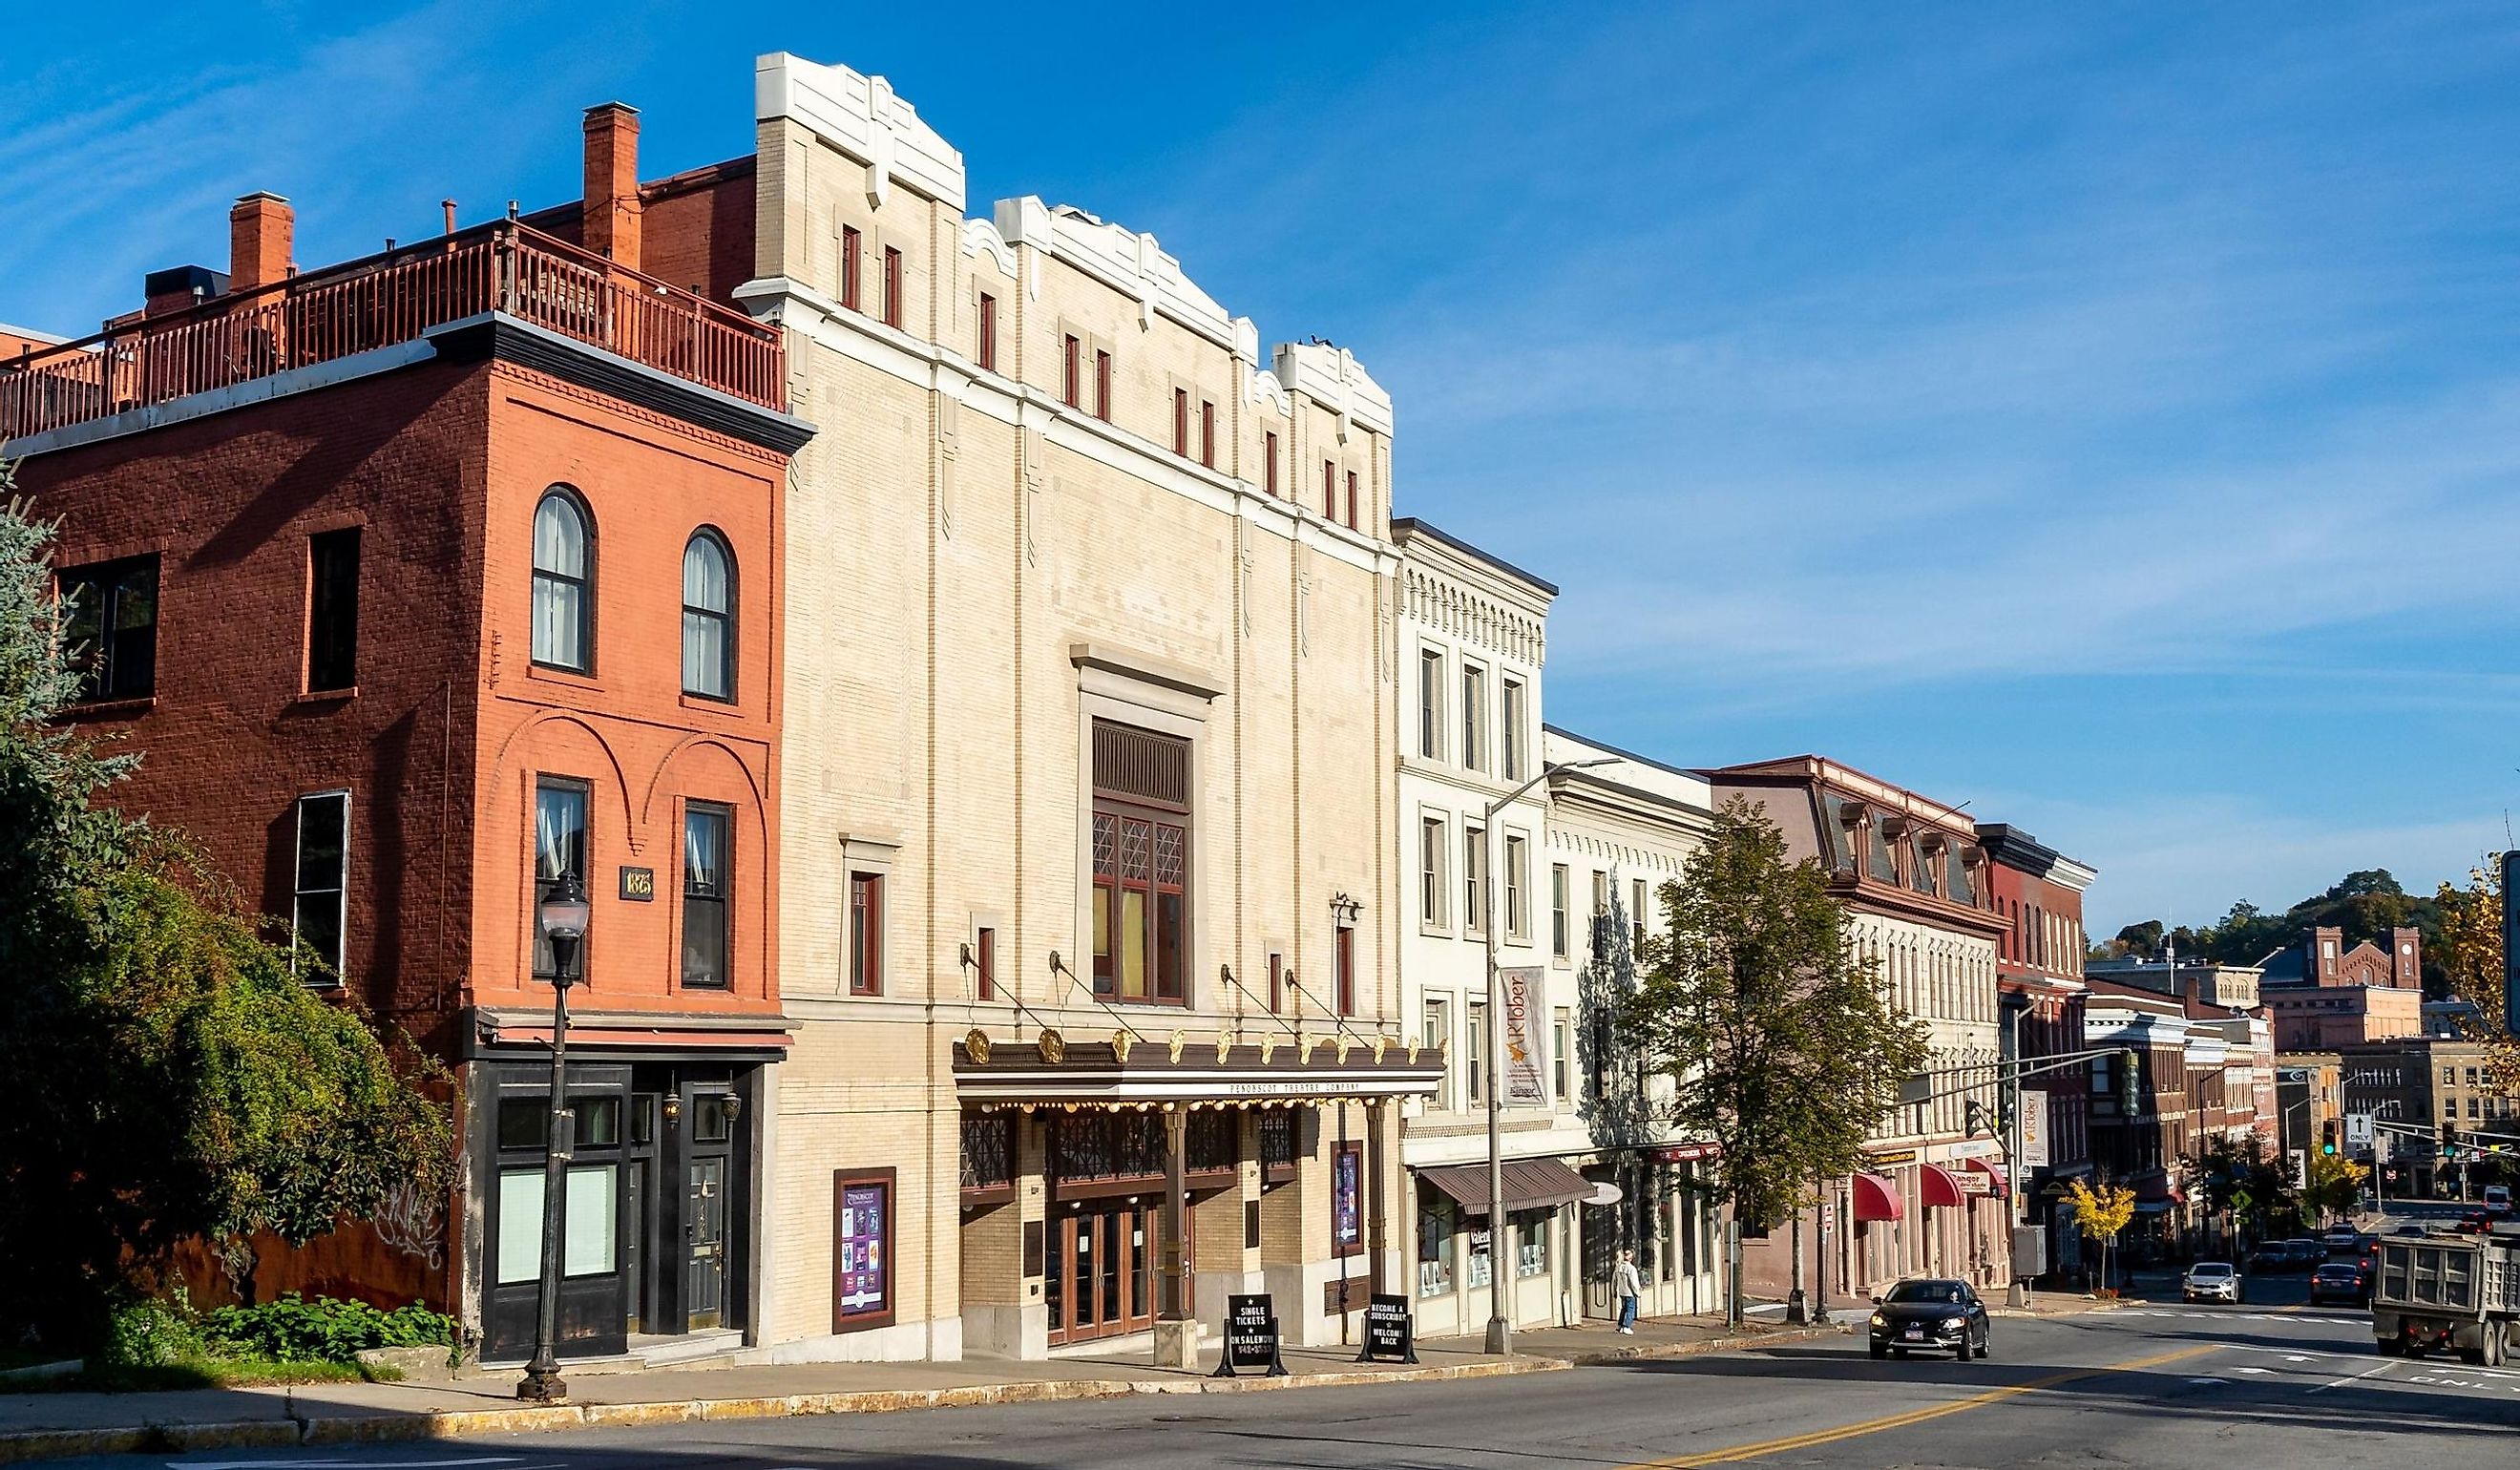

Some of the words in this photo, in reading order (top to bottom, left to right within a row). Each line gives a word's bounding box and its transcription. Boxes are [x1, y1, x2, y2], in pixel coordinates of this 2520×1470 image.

[1506, 976, 1525, 1053] ARTober
[1230, 1084, 1277, 1094] PENOBSCOT
[1284, 1084, 1319, 1093] THEATRE
[1326, 1083, 1359, 1092] COMPANY
[1240, 1307, 1265, 1316] SINGLE
[1371, 1304, 1396, 1312] BECOME
[1235, 1316, 1266, 1325] TICKETS
[1371, 1312, 1407, 1322] SUBSCRIBER
[1373, 1328, 1403, 1337] WELCOME
[1230, 1335, 1240, 1345] ON
[1241, 1335, 1259, 1344] SALE
[1380, 1336, 1397, 1346] BACK
